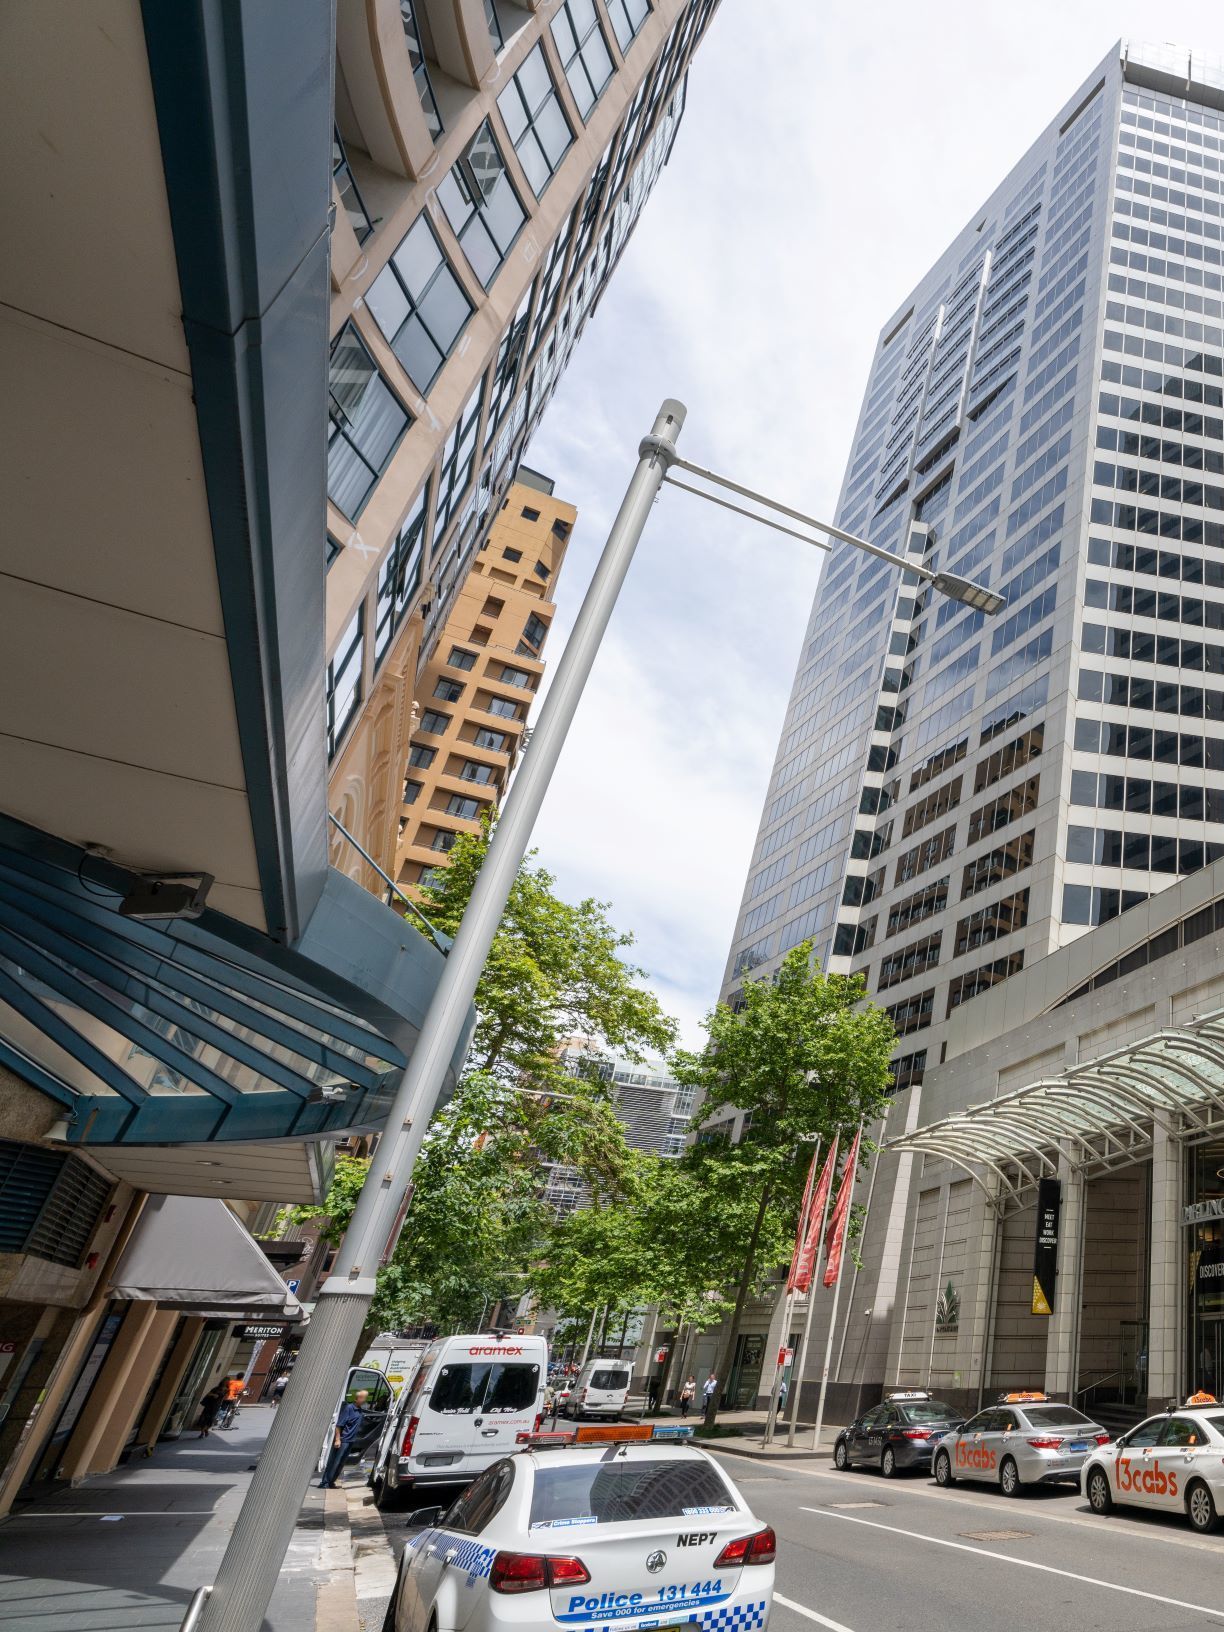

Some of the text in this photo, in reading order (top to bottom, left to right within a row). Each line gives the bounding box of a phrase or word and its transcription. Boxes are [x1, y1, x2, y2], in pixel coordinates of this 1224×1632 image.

[1199, 1262, 1224, 1279] DISCOVER
[244, 1325, 284, 1335] MERITON
[469, 1345, 523, 1356] aramex
[955, 1440, 997, 1469] 13cabs
[1115, 1457, 1178, 1497] 13cabs
[571, 1517, 596, 1525] Stoppers
[677, 1532, 718, 1548] NEP7
[568, 1578, 722, 1613] Police 131 444
[591, 1599, 700, 1620] Save 000 for emergencies
